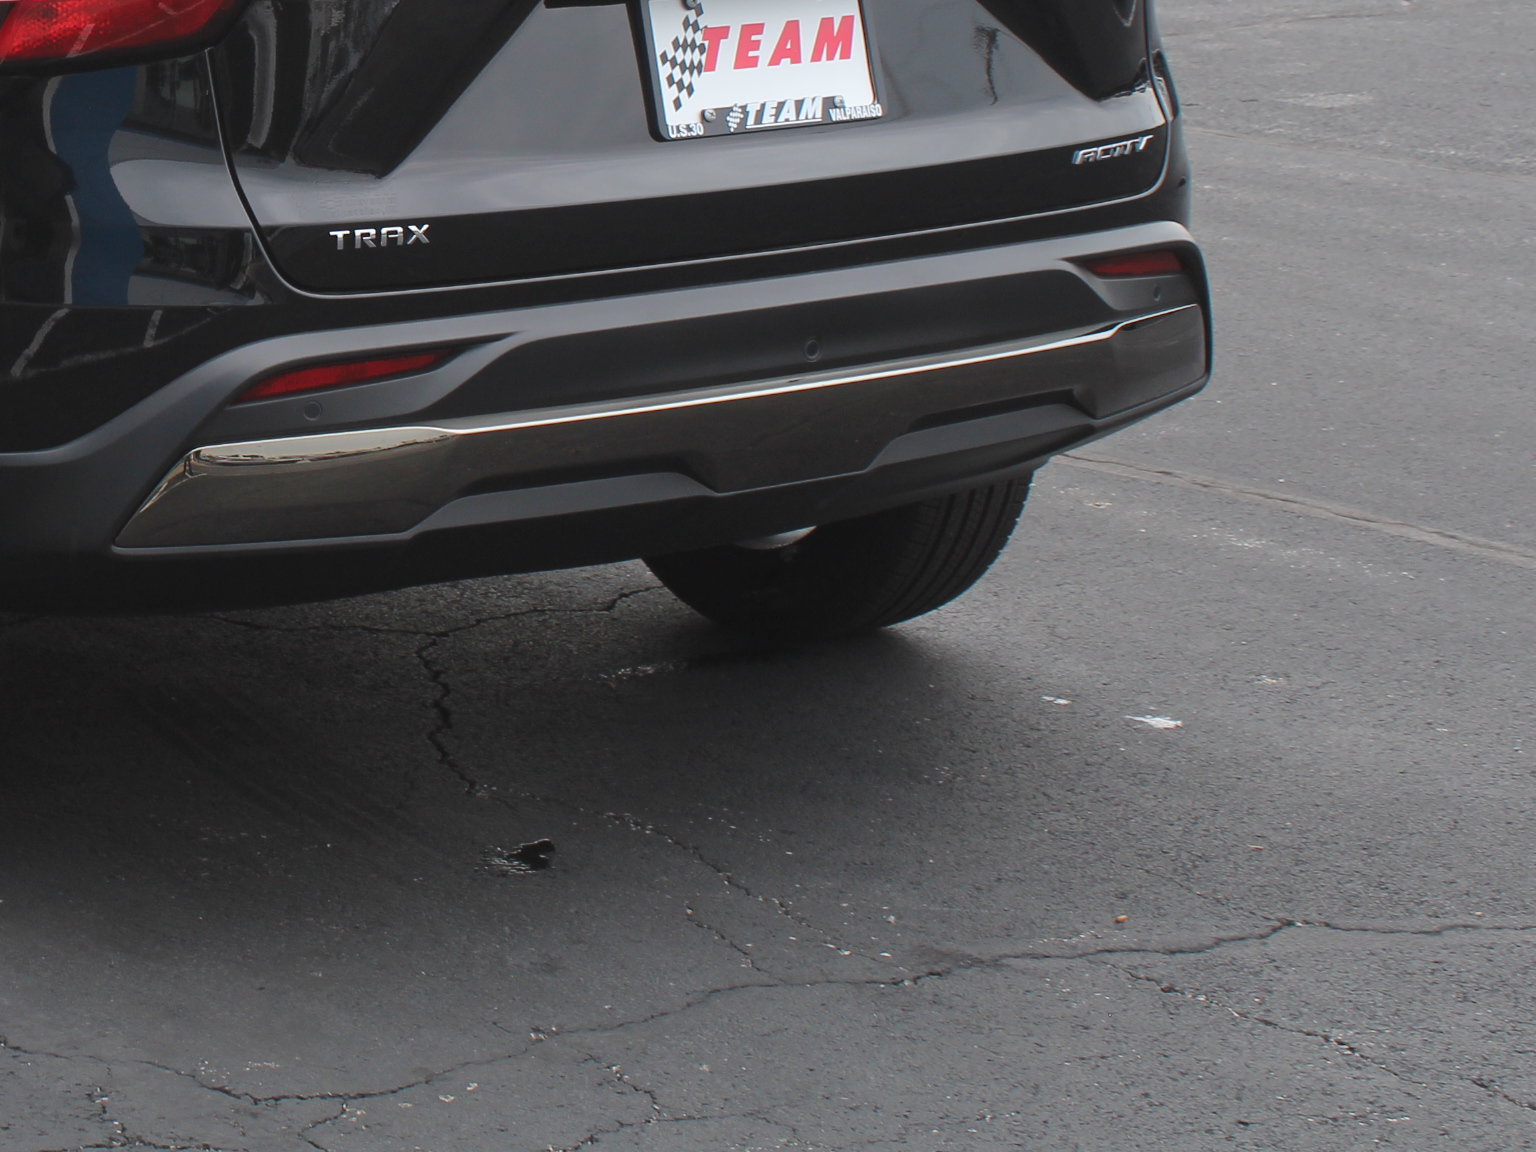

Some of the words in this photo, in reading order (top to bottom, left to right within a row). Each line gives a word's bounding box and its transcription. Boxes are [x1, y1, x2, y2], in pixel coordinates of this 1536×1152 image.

[701, 14, 856, 72] TEAM
[745, 95, 823, 126] TEAM
[828, 103, 882, 123] VALPARAISO
[328, 223, 431, 251] TRAX
